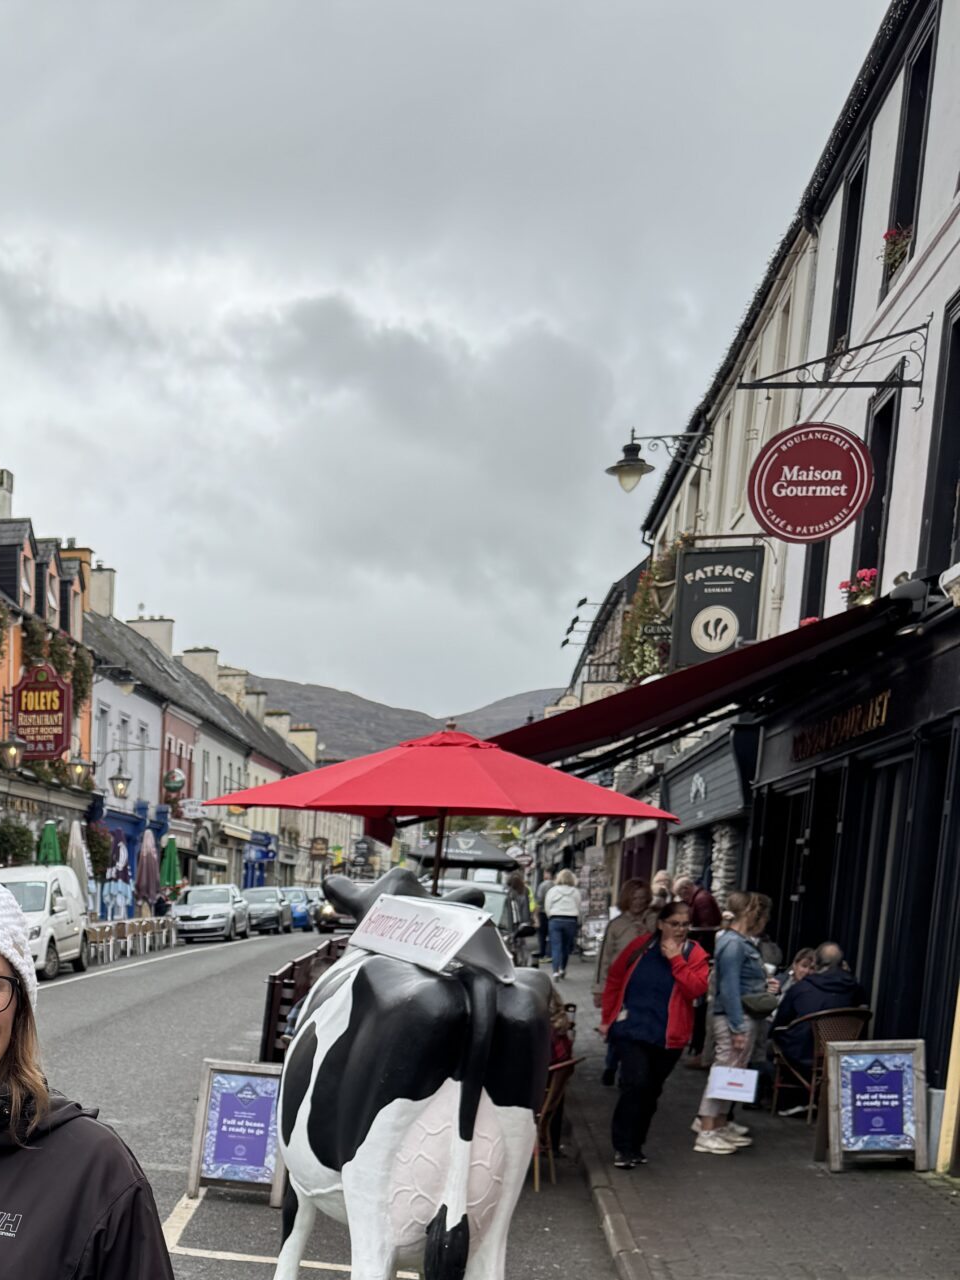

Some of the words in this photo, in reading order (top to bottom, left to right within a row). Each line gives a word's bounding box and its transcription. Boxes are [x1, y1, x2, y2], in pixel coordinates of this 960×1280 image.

[780, 432, 850, 452] BOULANGERIE
[780, 465, 842, 481] Maison
[771, 481, 849, 497] Gourmet
[766, 508, 787, 529] CAFÉ
[683, 565, 755, 585] FATFACE
[21, 689, 60, 711] FOLEYS
[27, 743, 55, 751] BAR
[228, 1126, 246, 1134] ready
